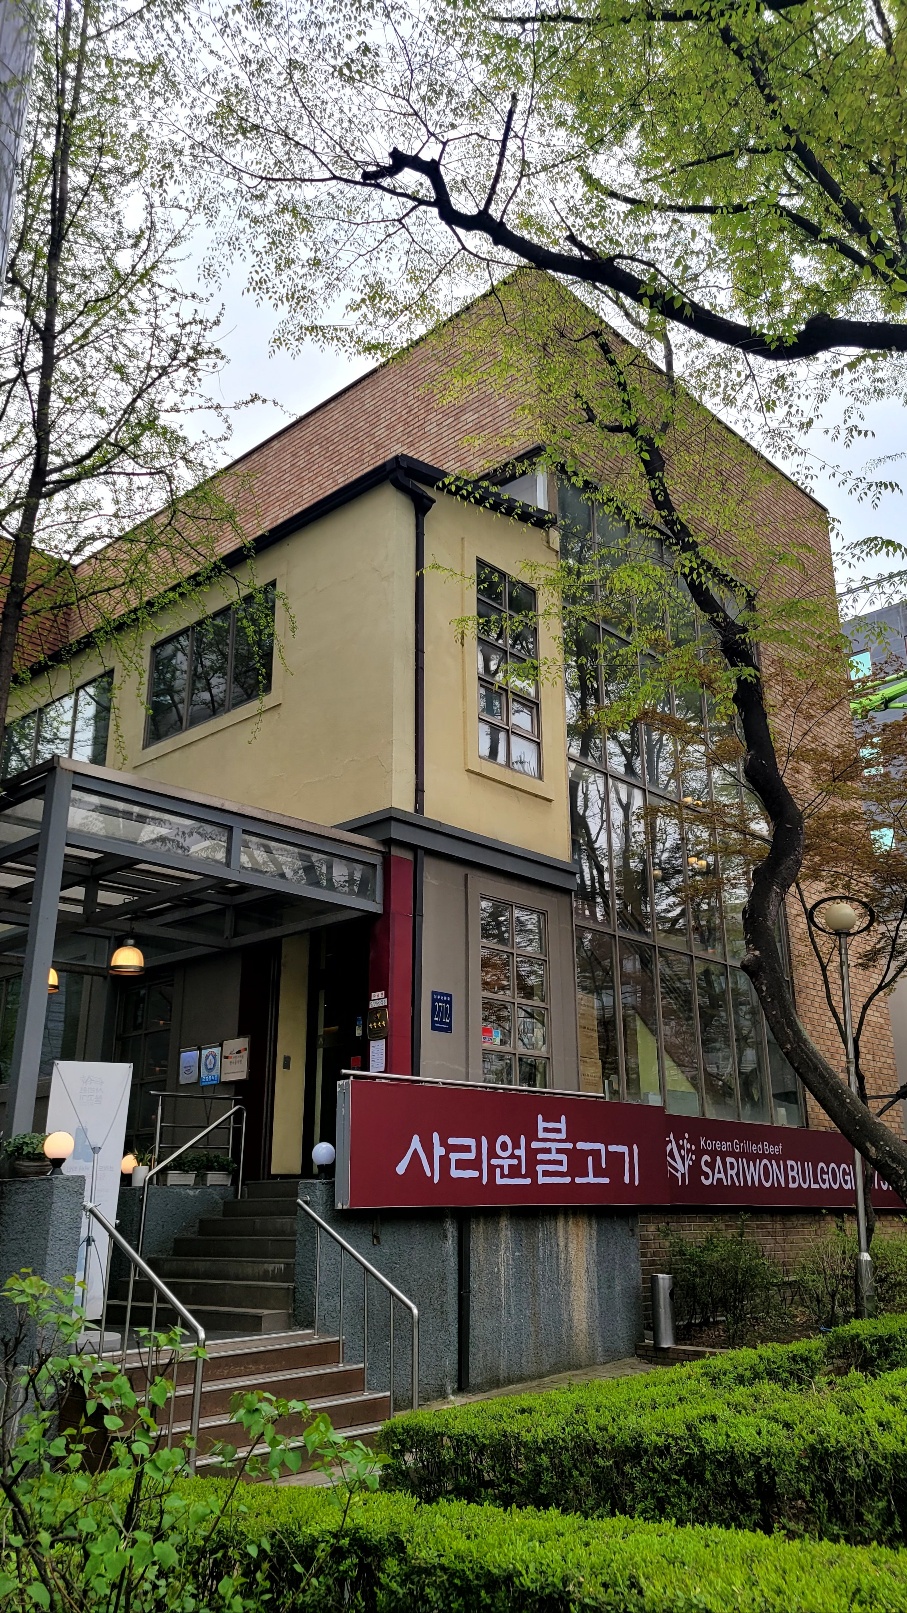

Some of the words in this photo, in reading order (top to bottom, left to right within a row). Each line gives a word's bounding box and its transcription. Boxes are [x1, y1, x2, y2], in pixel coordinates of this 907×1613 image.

[434, 1002, 450, 1022] 2712
[396, 1114, 640, 1186] 사리원불고기
[701, 1137, 732, 1151] Korean
[734, 1140, 762, 1154] Grilled
[763, 1141, 782, 1155] Beef
[701, 1155, 785, 1188] SARIWON
[788, 1160, 856, 1190] BULGOGI
